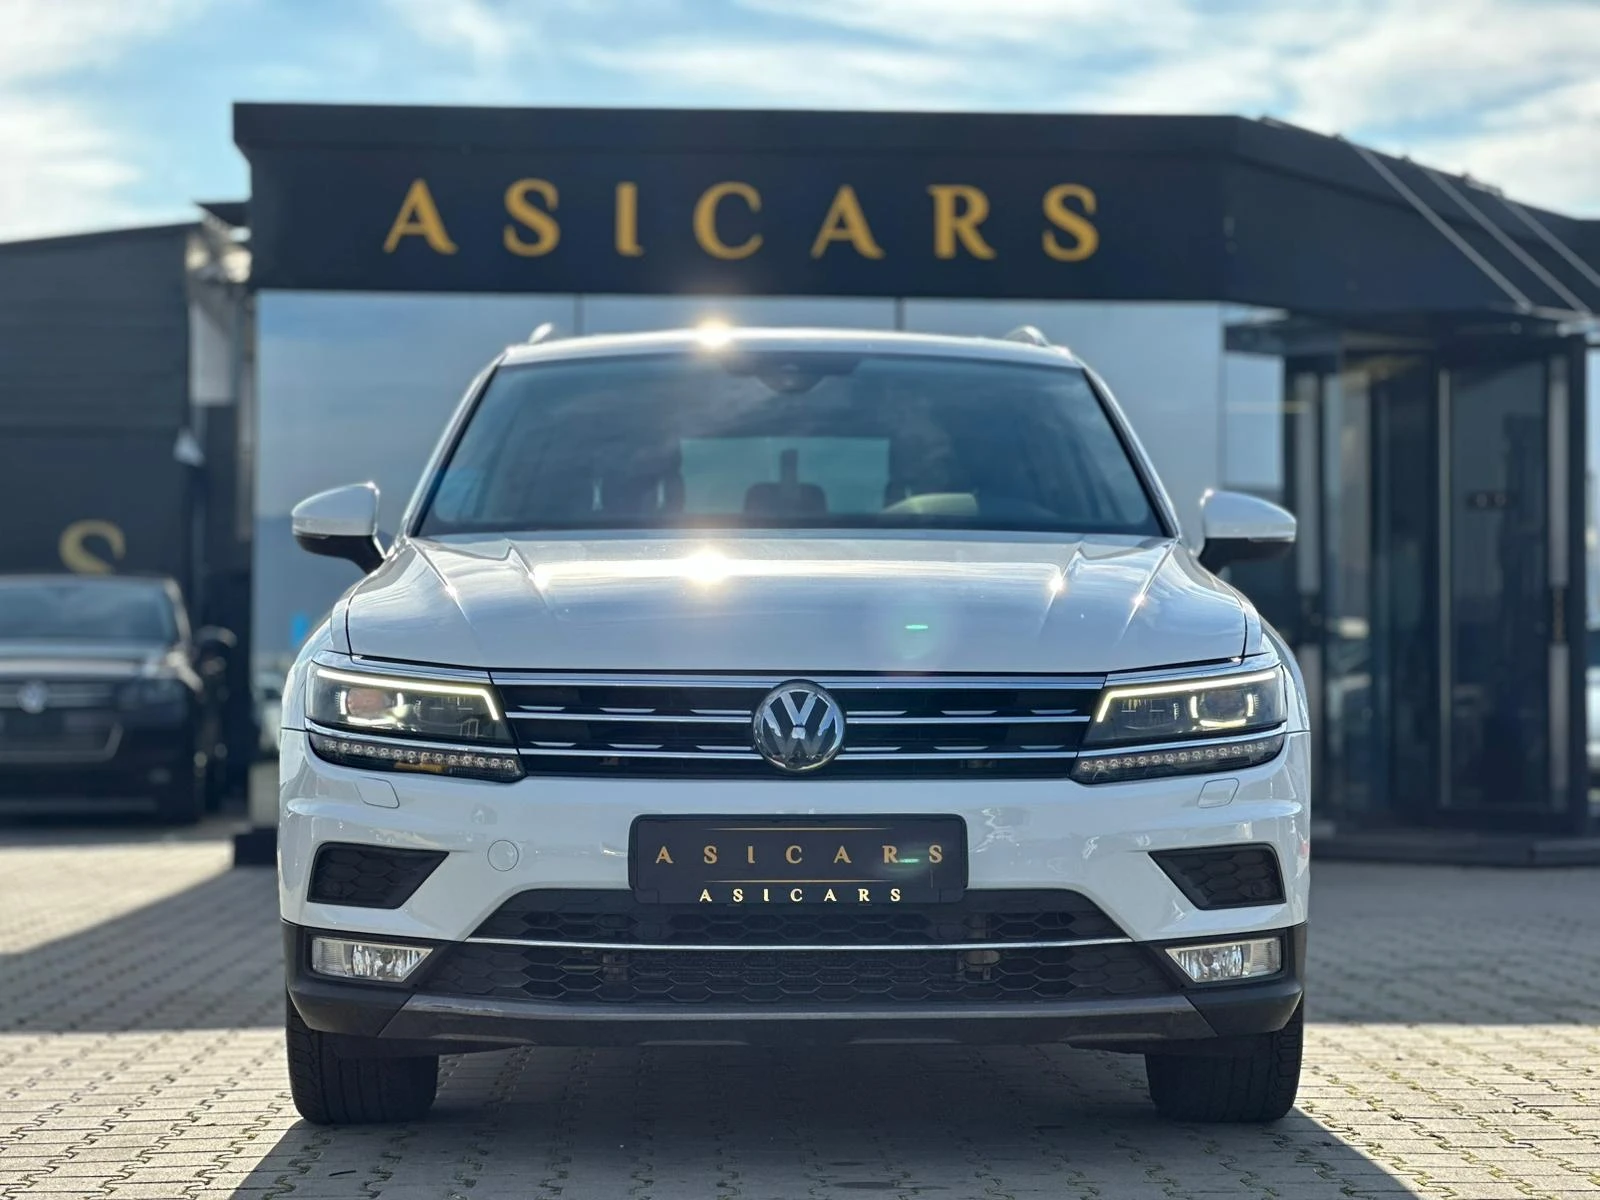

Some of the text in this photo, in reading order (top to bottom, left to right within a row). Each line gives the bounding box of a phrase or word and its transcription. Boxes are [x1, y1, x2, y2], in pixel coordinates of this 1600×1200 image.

[382, 178, 1100, 263] ASICARS
[756, 683, 842, 768] VW
[655, 844, 944, 865] ASICARS
[699, 887, 902, 903] ASICARS
